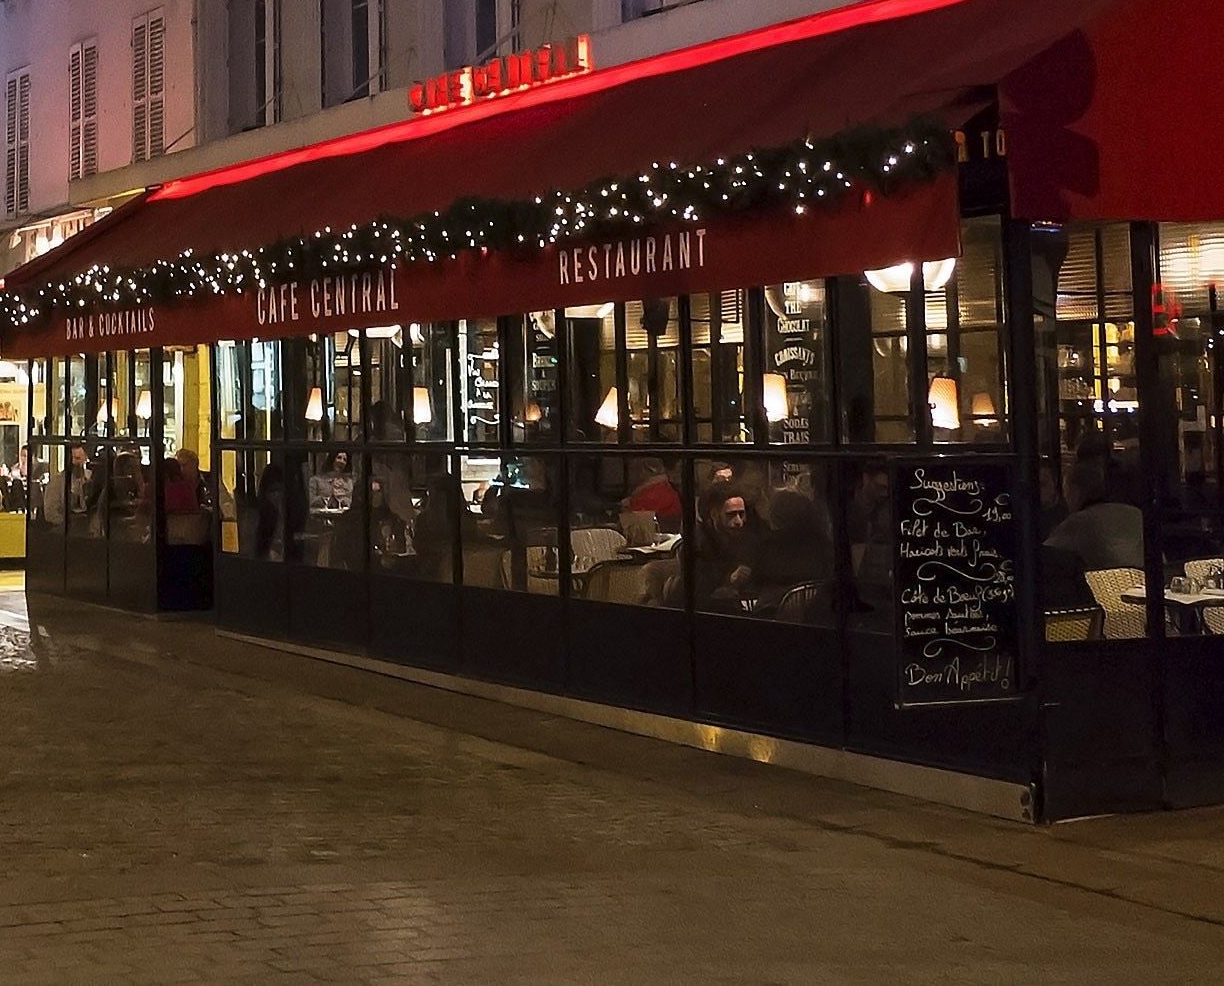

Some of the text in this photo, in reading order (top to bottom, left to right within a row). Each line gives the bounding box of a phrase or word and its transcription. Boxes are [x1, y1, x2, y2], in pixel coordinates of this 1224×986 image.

[559, 228, 706, 285] RESTAURANT
[257, 268, 399, 325] CAFE CENTRAL
[66, 307, 154, 340] BAR & COCKTAILS
[934, 521, 950, 538] de
[933, 587, 947, 604] de
[904, 663, 943, 686] Bon
